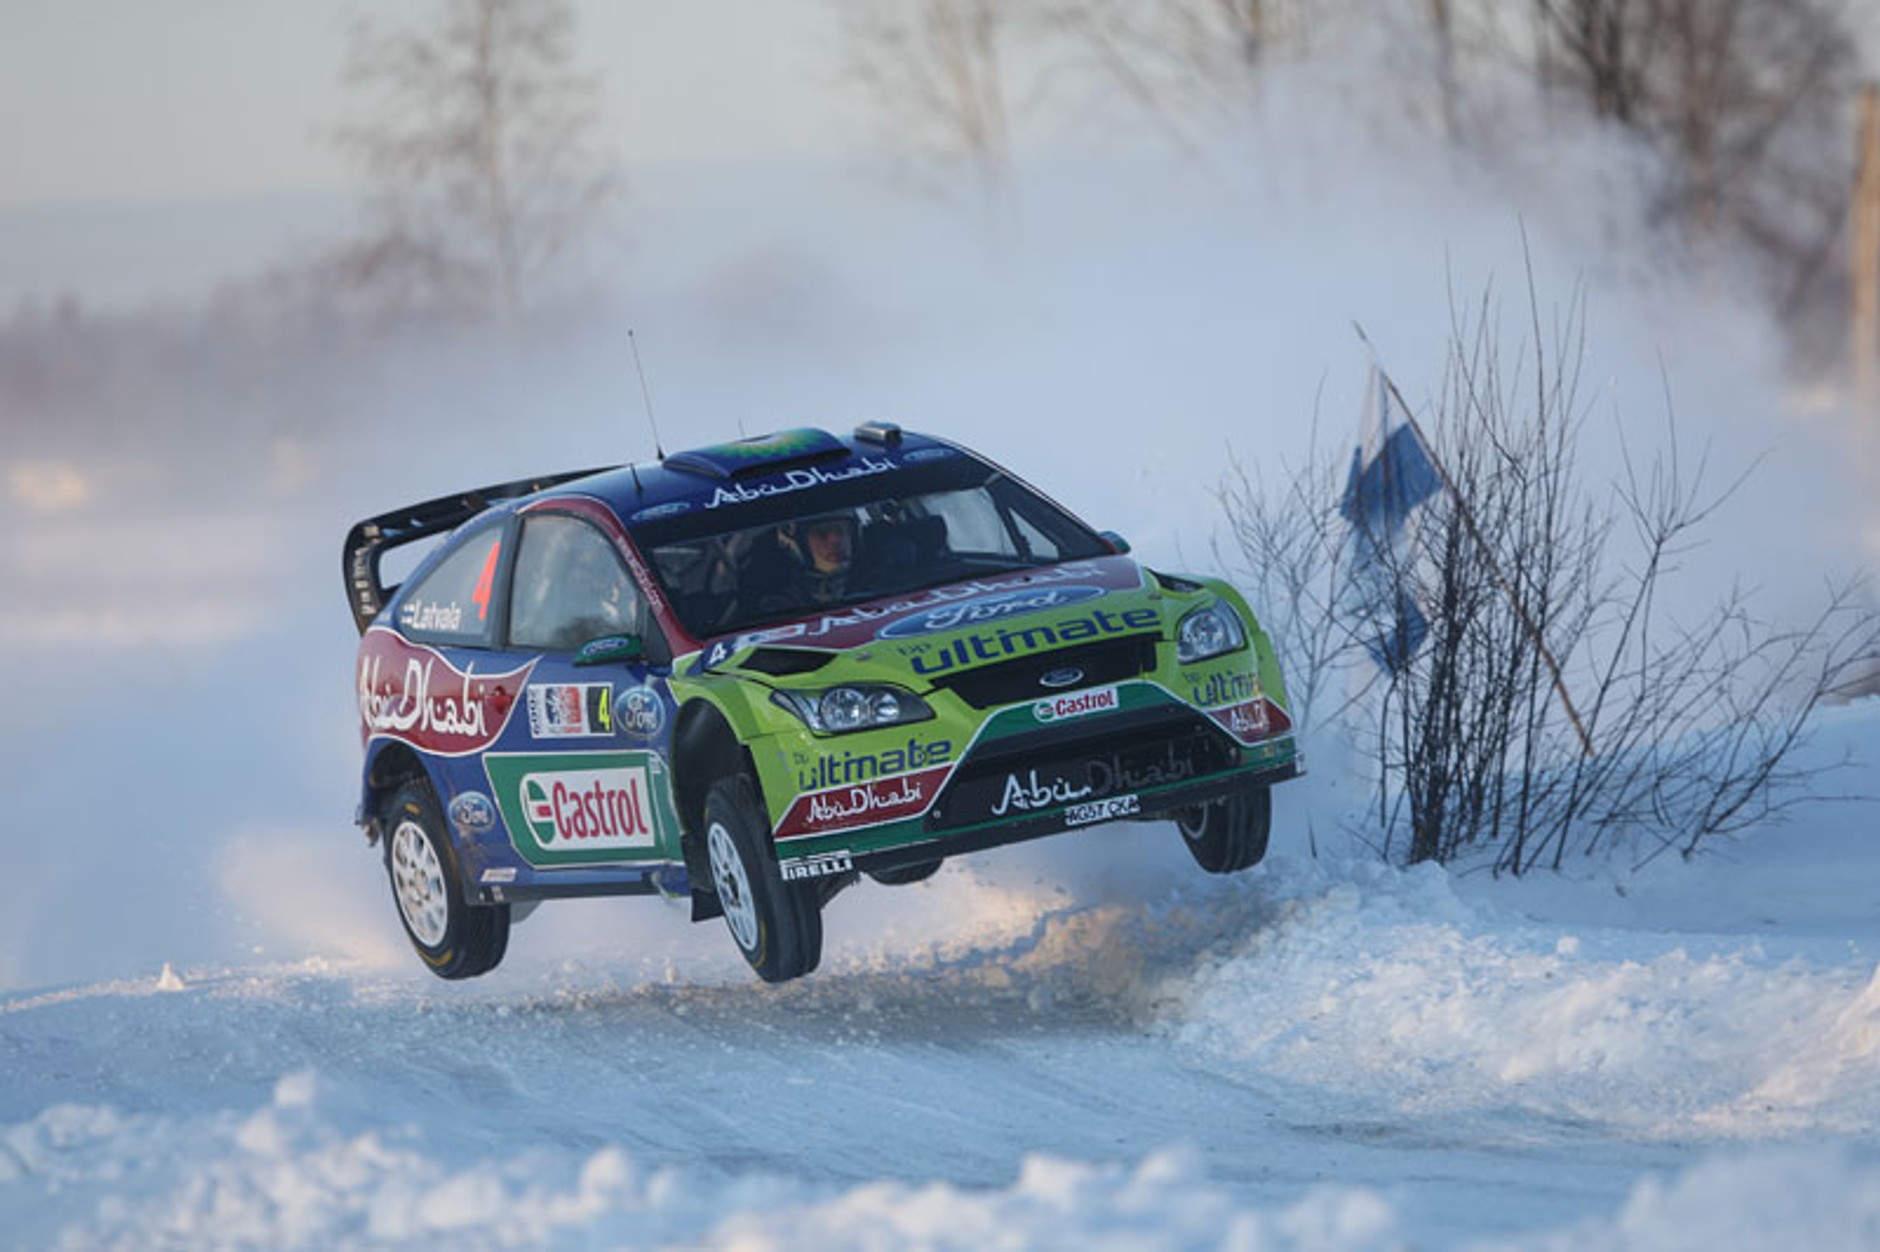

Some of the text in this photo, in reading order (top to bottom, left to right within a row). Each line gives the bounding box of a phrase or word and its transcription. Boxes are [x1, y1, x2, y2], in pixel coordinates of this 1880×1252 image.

[472, 541, 500, 621] 4
[925, 591, 1069, 630] Ford
[708, 643, 727, 665] 4
[911, 608, 1162, 676] ultimate
[599, 688, 611, 732] 4
[1055, 690, 1115, 716] Castrol
[799, 739, 952, 790] ultimate
[552, 777, 648, 840] Castrol
[780, 850, 853, 880] PIRELLI
